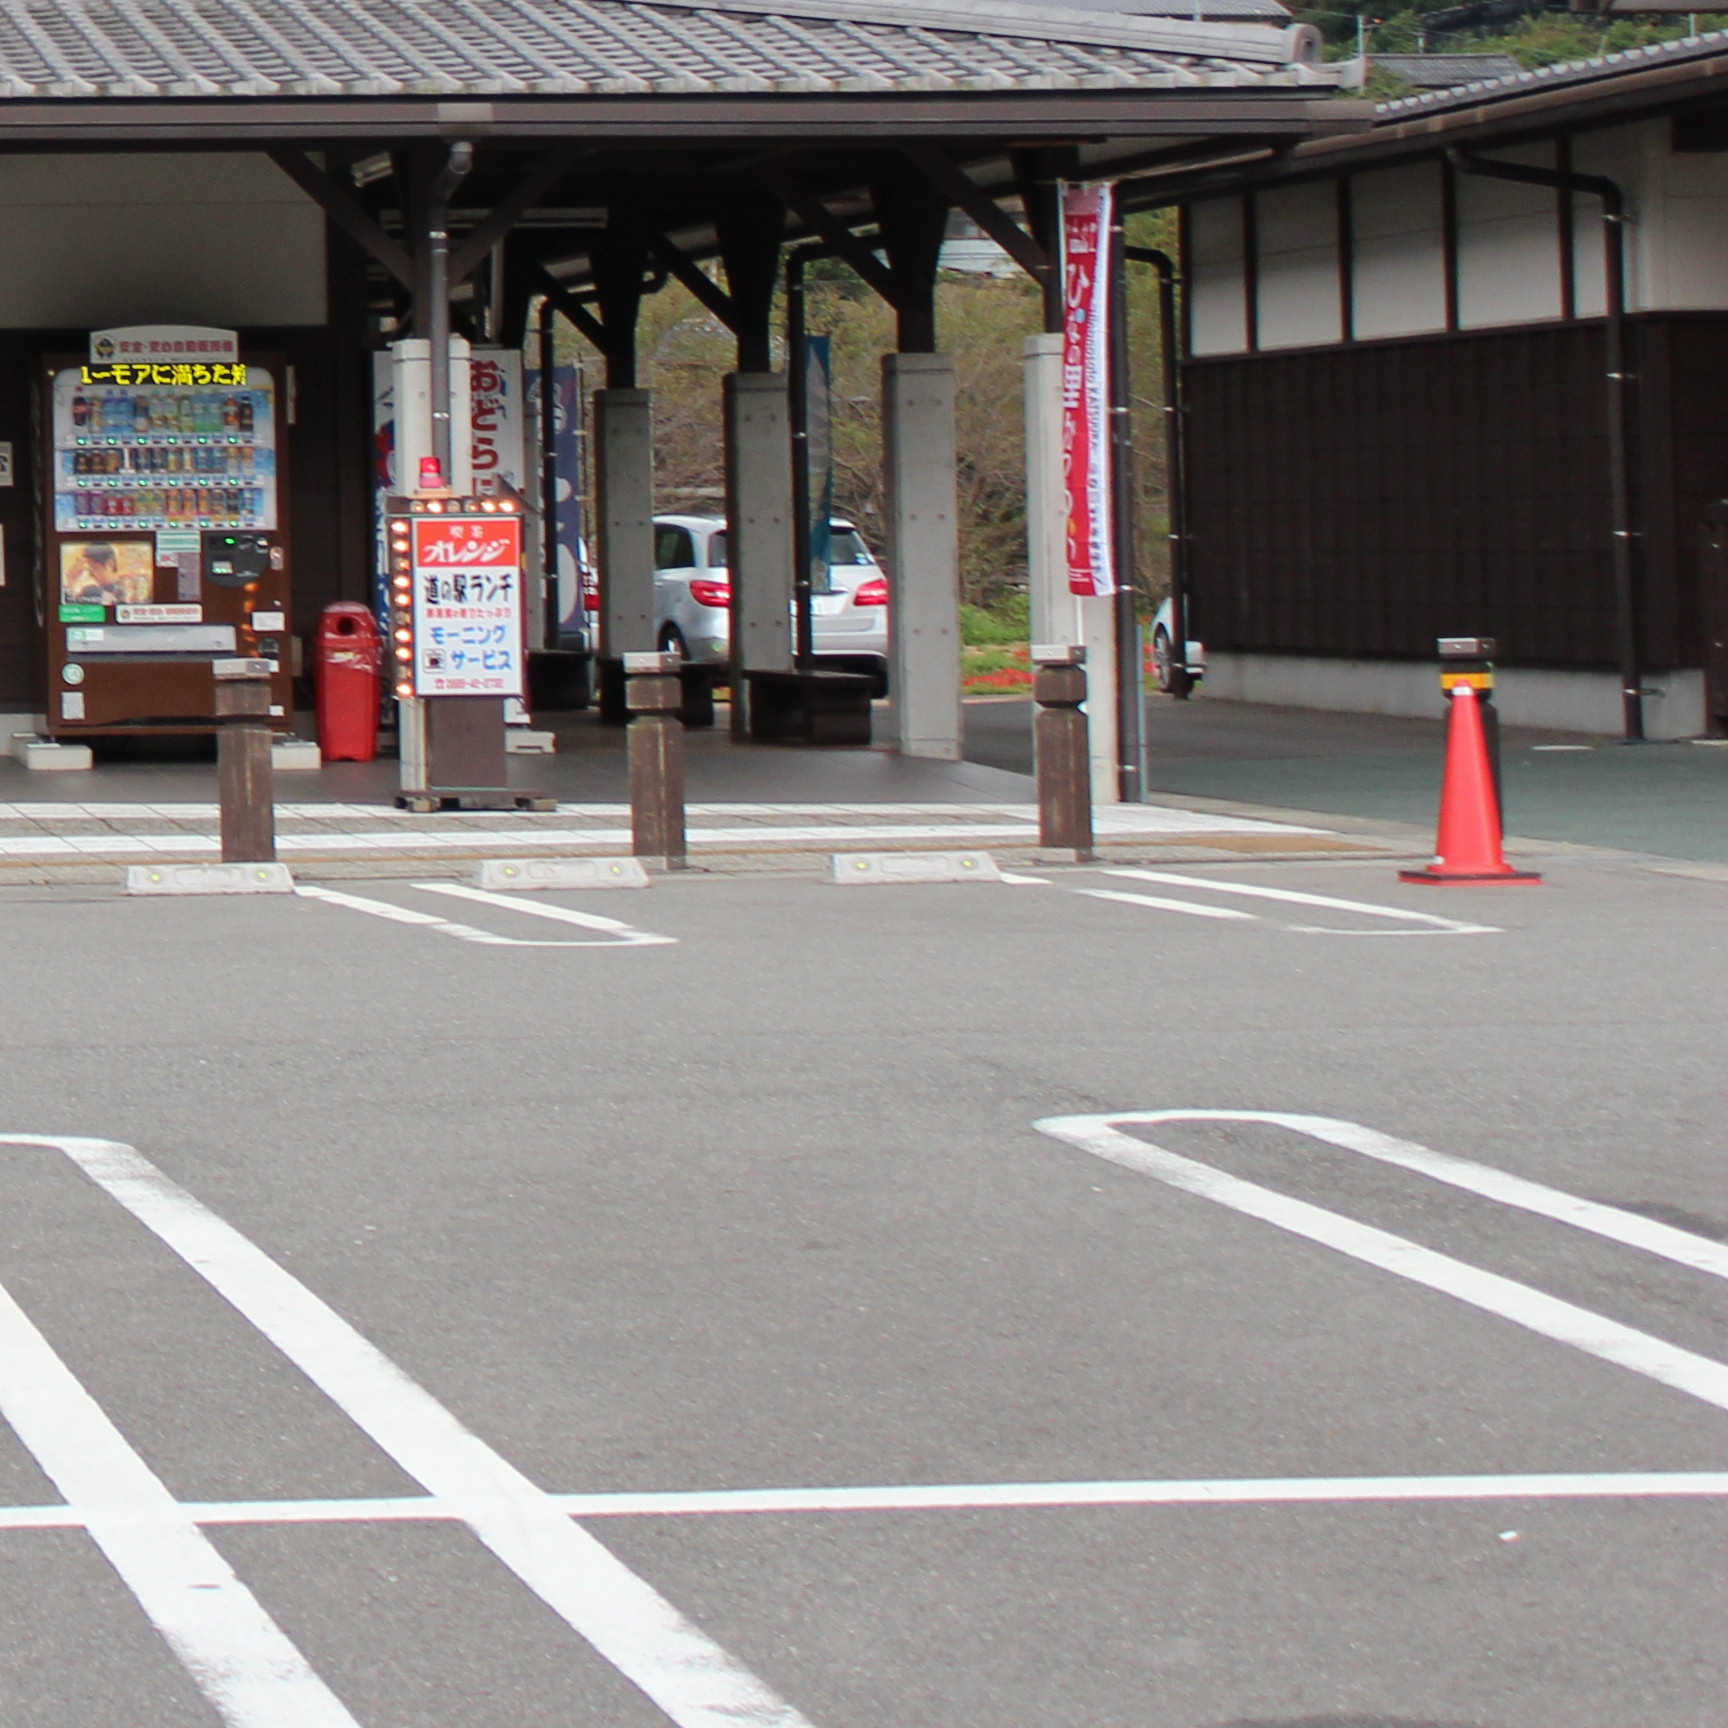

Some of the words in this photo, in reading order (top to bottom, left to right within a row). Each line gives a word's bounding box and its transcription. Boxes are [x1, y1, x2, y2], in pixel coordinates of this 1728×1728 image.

[423, 539, 511, 564] オレンジ
[424, 573, 513, 605] 道の駅ランチ
[430, 626, 506, 645] モーニング
[451, 651, 513, 670] サービス
